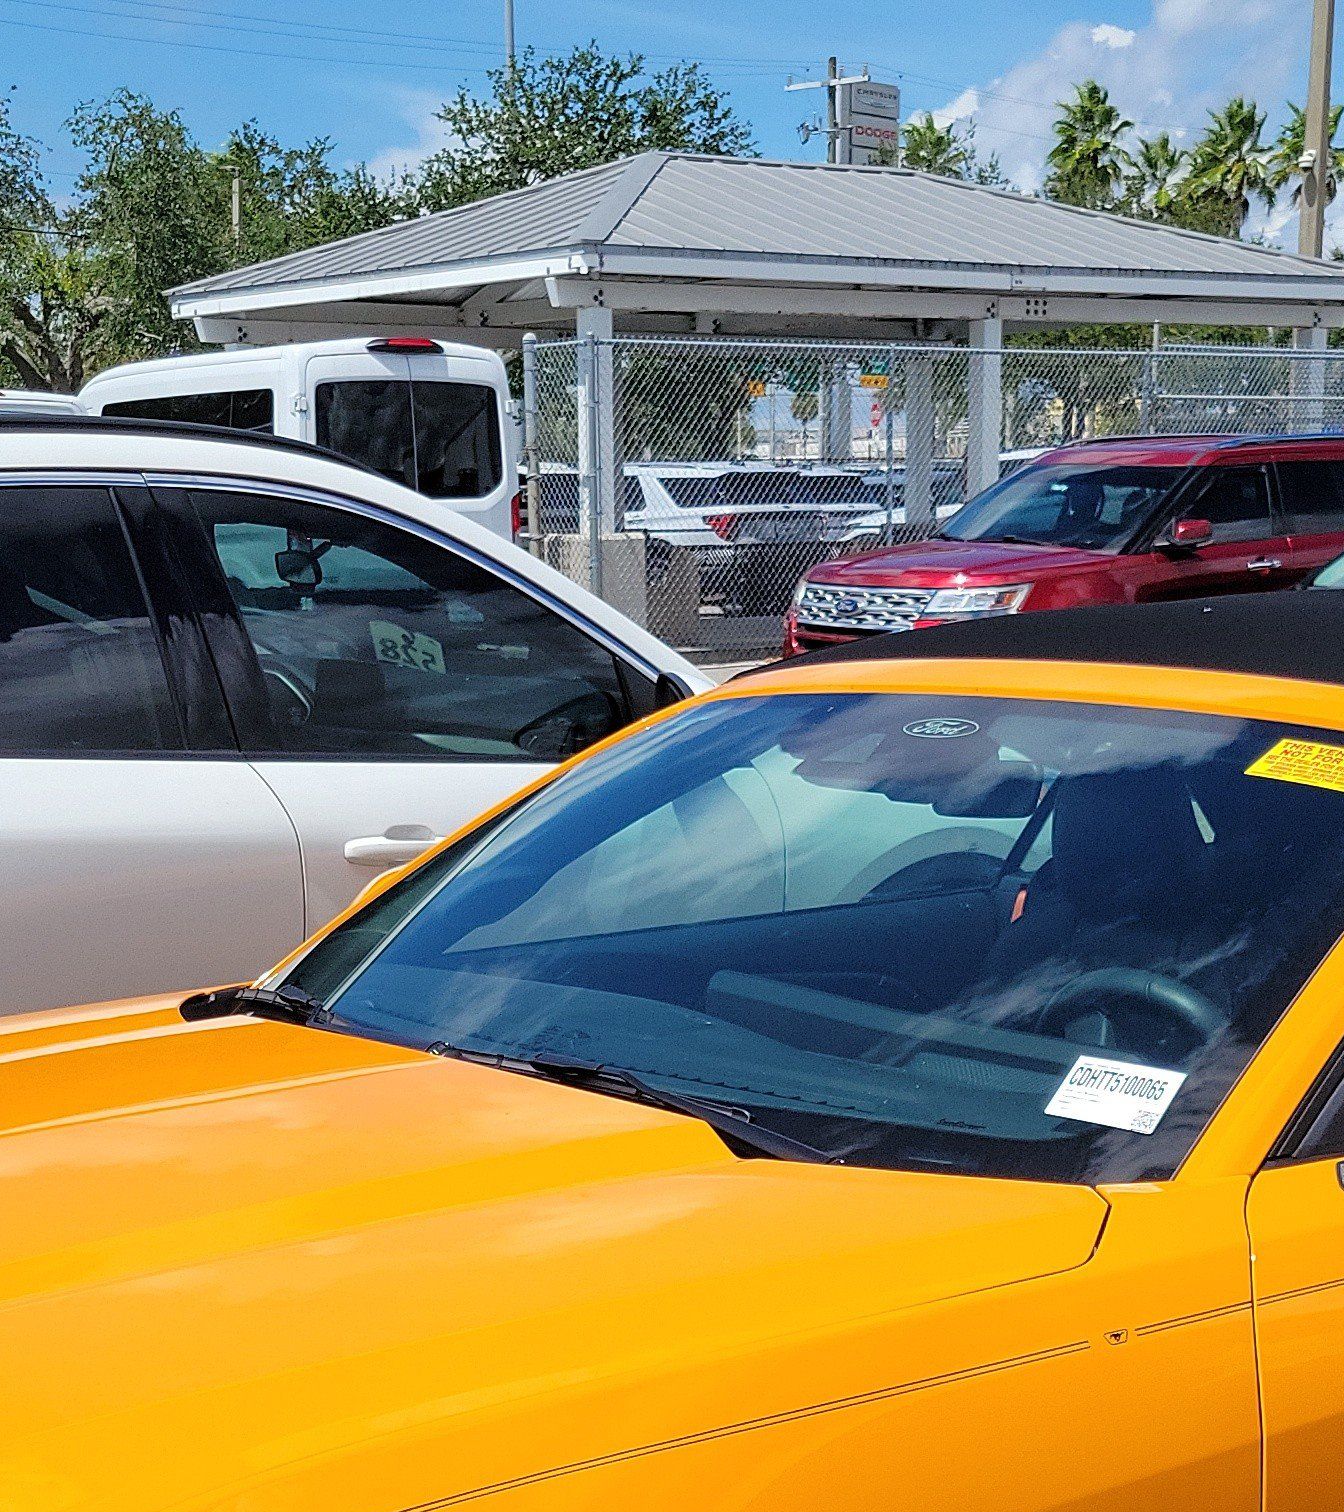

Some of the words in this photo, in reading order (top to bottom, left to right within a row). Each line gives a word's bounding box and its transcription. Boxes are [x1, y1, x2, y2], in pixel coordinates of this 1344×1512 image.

[856, 125, 897, 139] DODGE
[1283, 741, 1316, 752] THIS
[1279, 749, 1310, 759] NOT
[1312, 754, 1342, 765] FOR
[1069, 1066, 1169, 1101] CDHTT5100065
